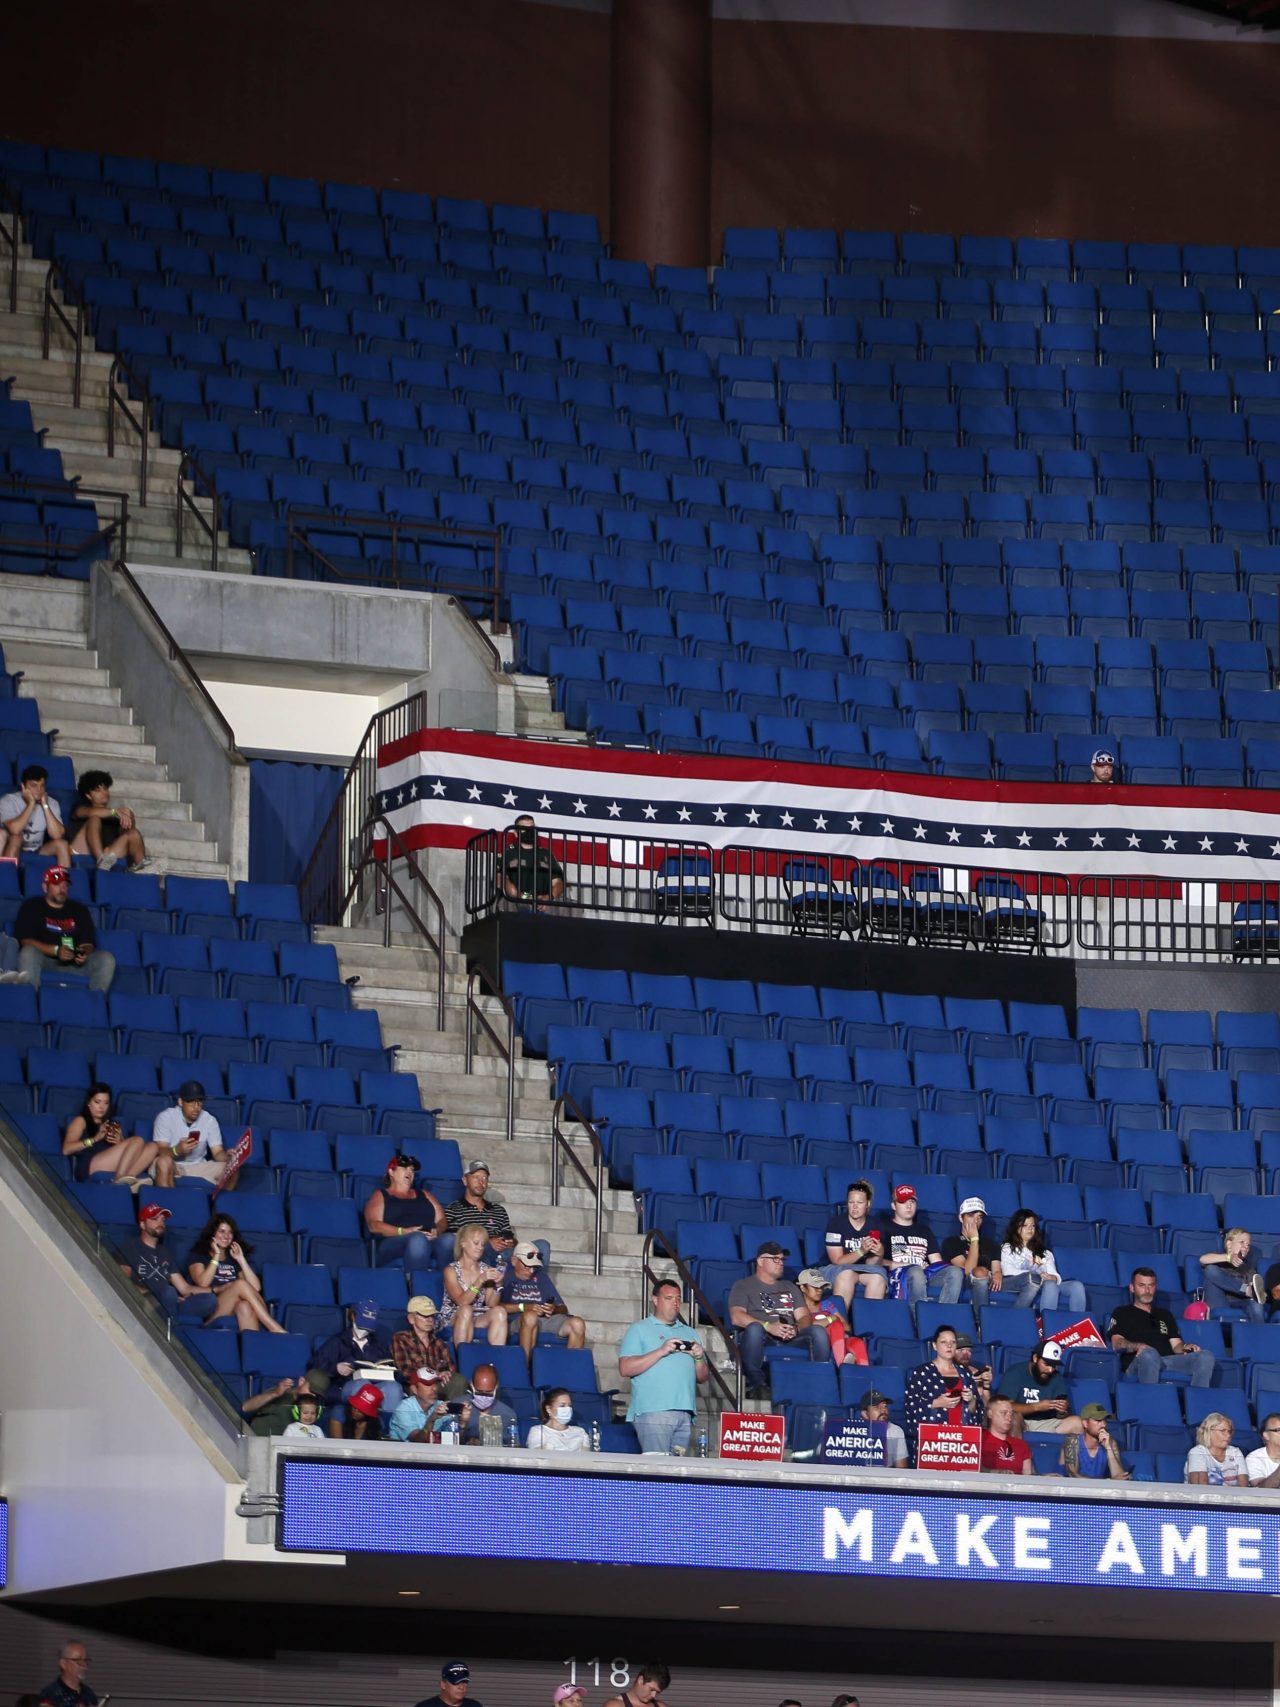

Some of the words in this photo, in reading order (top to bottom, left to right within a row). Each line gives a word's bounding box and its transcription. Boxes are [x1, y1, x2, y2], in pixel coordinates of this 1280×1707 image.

[907, 1236, 928, 1247] GUNS
[1058, 1332, 1081, 1346] MAKE
[740, 1420, 765, 1430] MAKE
[842, 1426, 868, 1436] MAKE
[937, 1431, 963, 1441] MAKE
[723, 1430, 781, 1444] AMERICA
[825, 1436, 884, 1449] AMERICA
[722, 1443, 752, 1453] GREAT
[752, 1444, 781, 1454] AGAIN
[921, 1441, 979, 1454] AMERICA
[825, 1449, 854, 1458] GREAT
[855, 1450, 884, 1460] AGAIN
[921, 1454, 949, 1463] GREAT
[950, 1455, 978, 1465] AGAIN
[821, 1506, 1052, 1570] MAKE
[562, 1655, 630, 1688] 118
